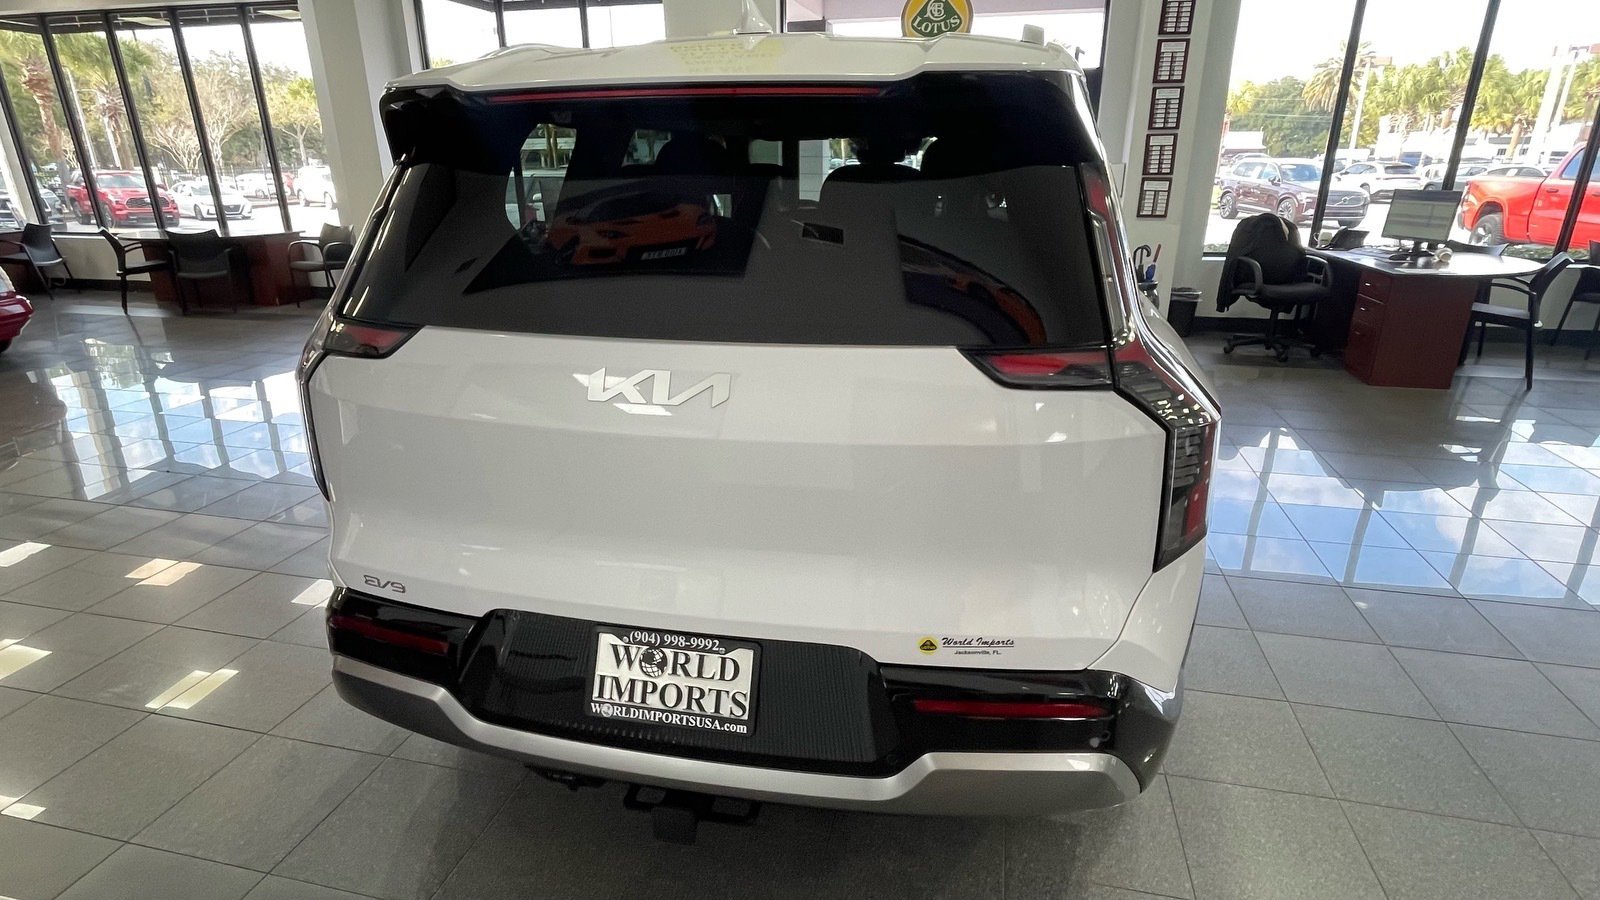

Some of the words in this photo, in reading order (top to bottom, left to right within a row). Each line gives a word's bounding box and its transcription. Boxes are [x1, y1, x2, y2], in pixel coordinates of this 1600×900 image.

[913, 15, 960, 33] LOTUS
[588, 367, 731, 408] KIA
[363, 574, 406, 594] EV9
[629, 630, 661, 647] (904)
[663, 633, 720, 651] 998-9992
[941, 637, 974, 646] World
[976, 637, 1015, 647] Imports
[610, 643, 740, 682] WORLD
[594, 674, 748, 718] IMPORTS
[590, 702, 748, 734] WORLDIMPORTSUSA.com
